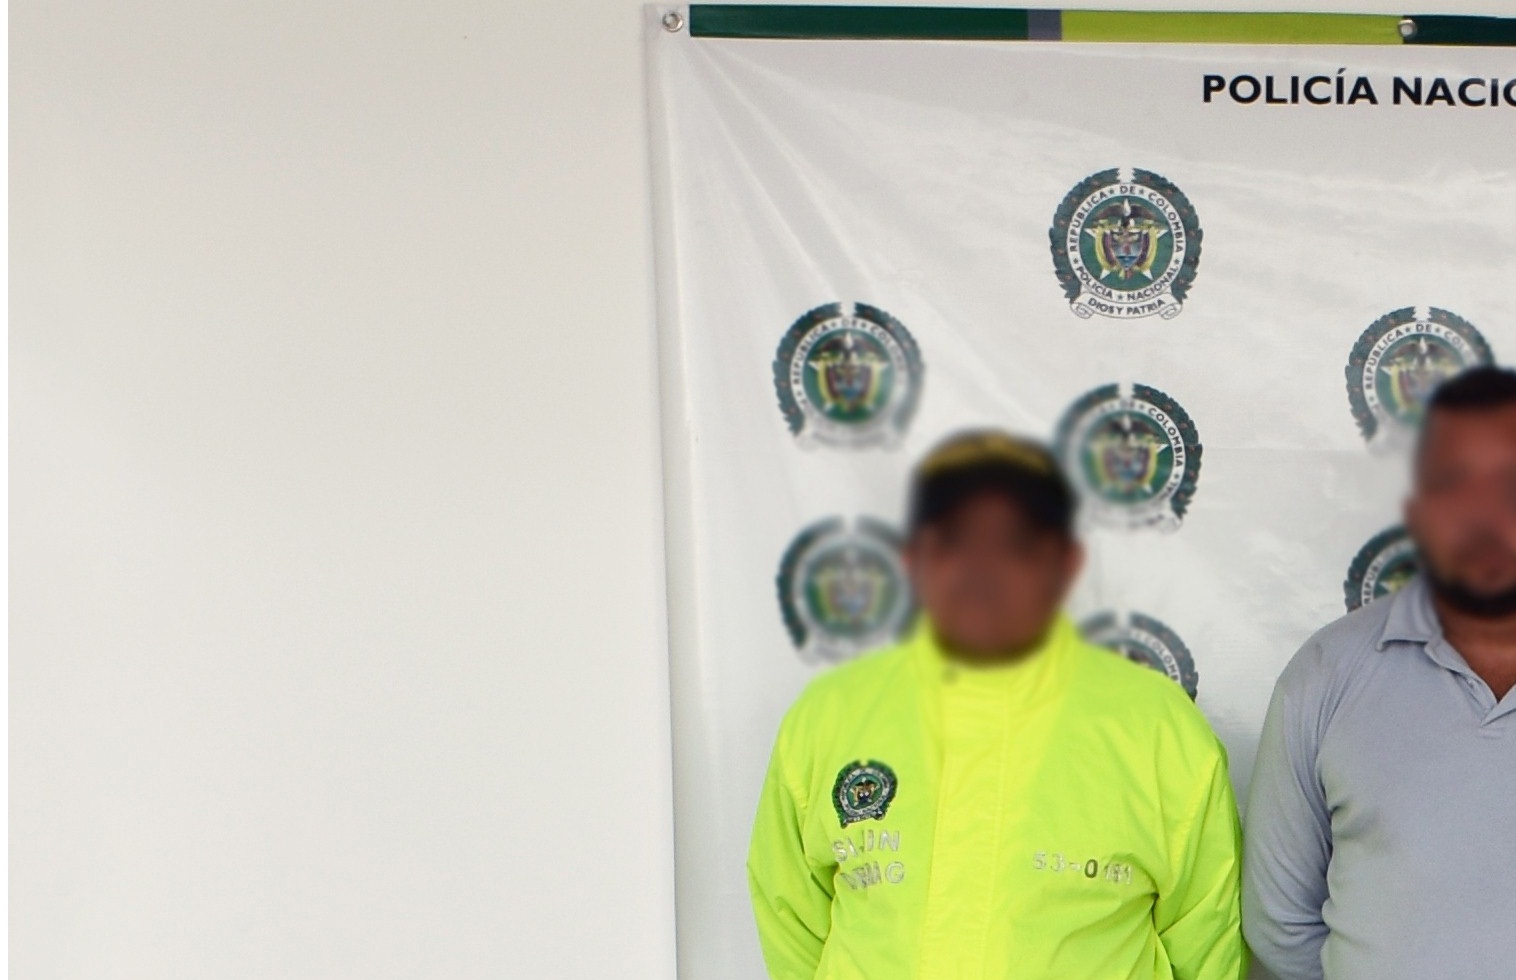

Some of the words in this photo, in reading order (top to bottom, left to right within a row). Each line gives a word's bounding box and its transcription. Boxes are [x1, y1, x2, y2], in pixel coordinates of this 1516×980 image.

[1202, 68, 1378, 105] POLICÍA
[1120, 185, 1135, 194] DE
[1148, 192, 1183, 252] COLOMBIA
[1127, 267, 1178, 301] NACIONAL
[1127, 299, 1166, 315] PATRIA
[1416, 324, 1431, 332] DE
[1149, 407, 1183, 467] COLOMBIA
